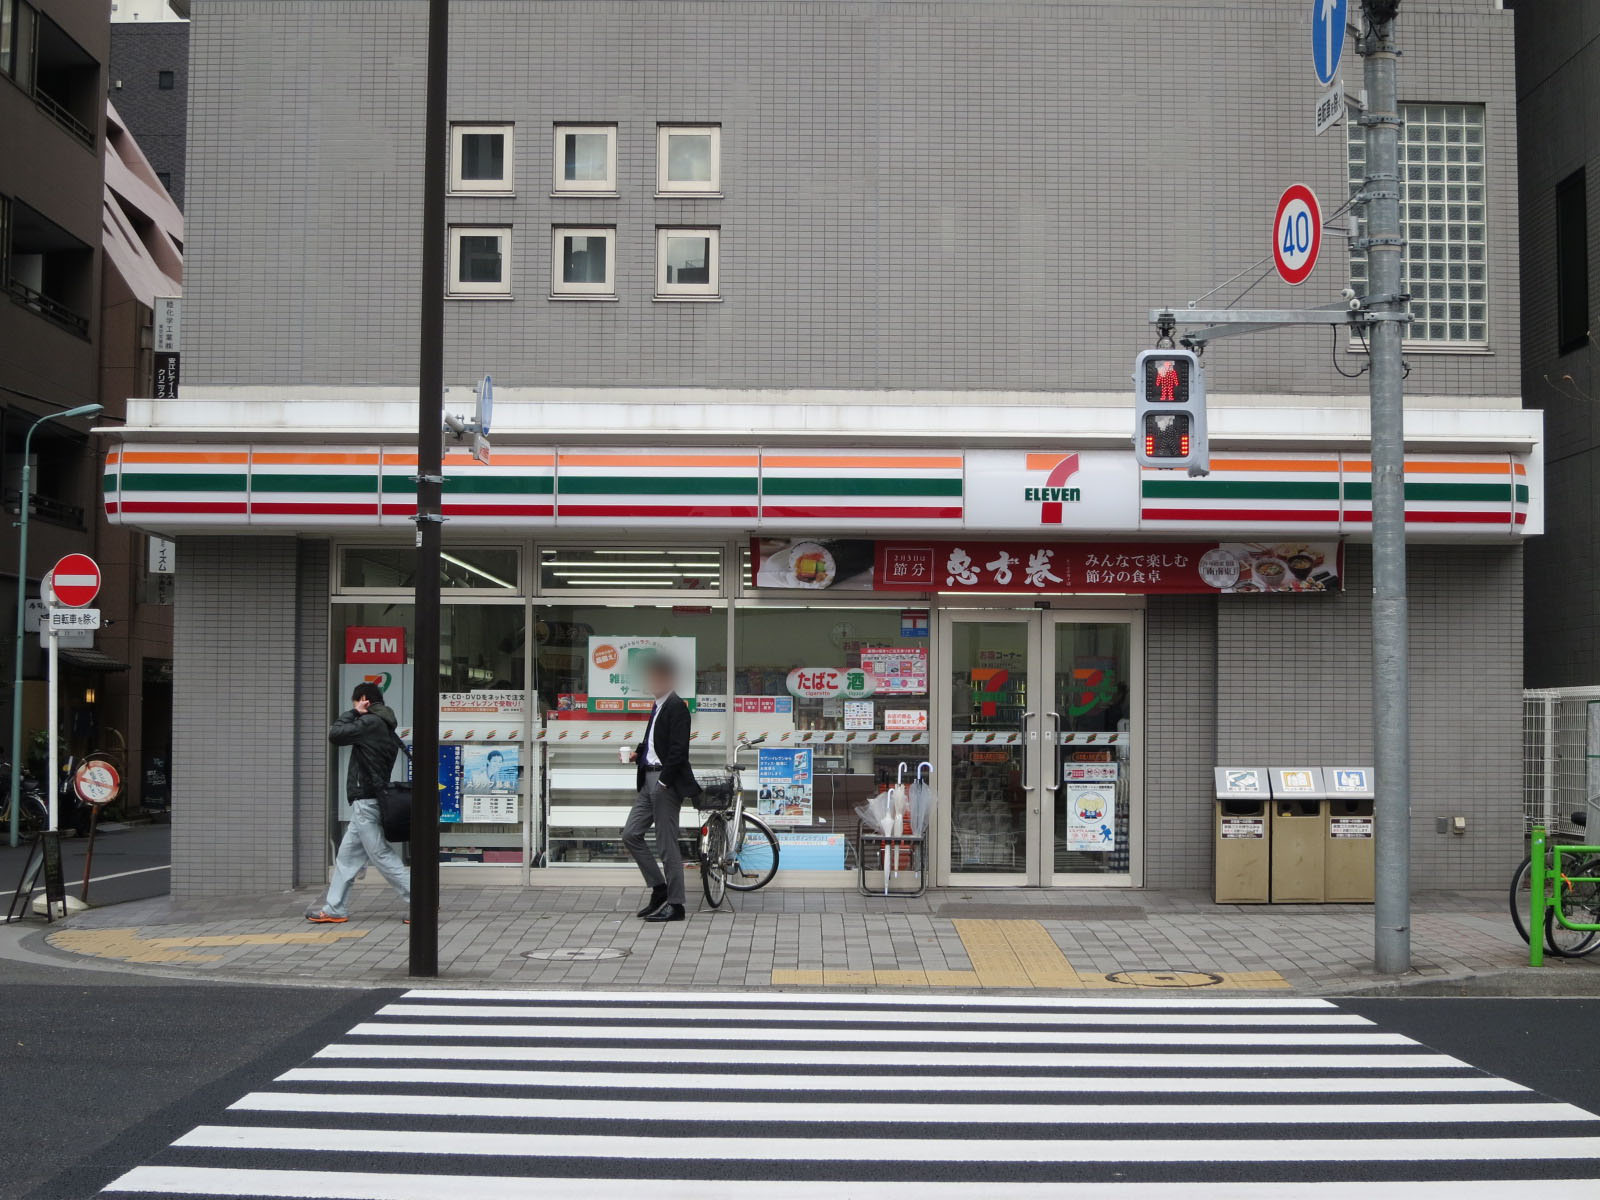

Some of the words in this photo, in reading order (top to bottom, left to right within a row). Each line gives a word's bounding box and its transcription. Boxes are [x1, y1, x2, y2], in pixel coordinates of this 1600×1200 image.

[1283, 211, 1309, 256] 40
[946, 548, 1064, 587] 恵方巻
[1085, 554, 1189, 568] みんなで楽しむ
[892, 562, 926, 577] 節分
[1085, 569, 1161, 584] 節分の食卓
[53, 613, 97, 625] 自転車を除く
[352, 638, 398, 653] ATM
[797, 672, 839, 690] たばこ
[846, 672, 865, 690] 酒
